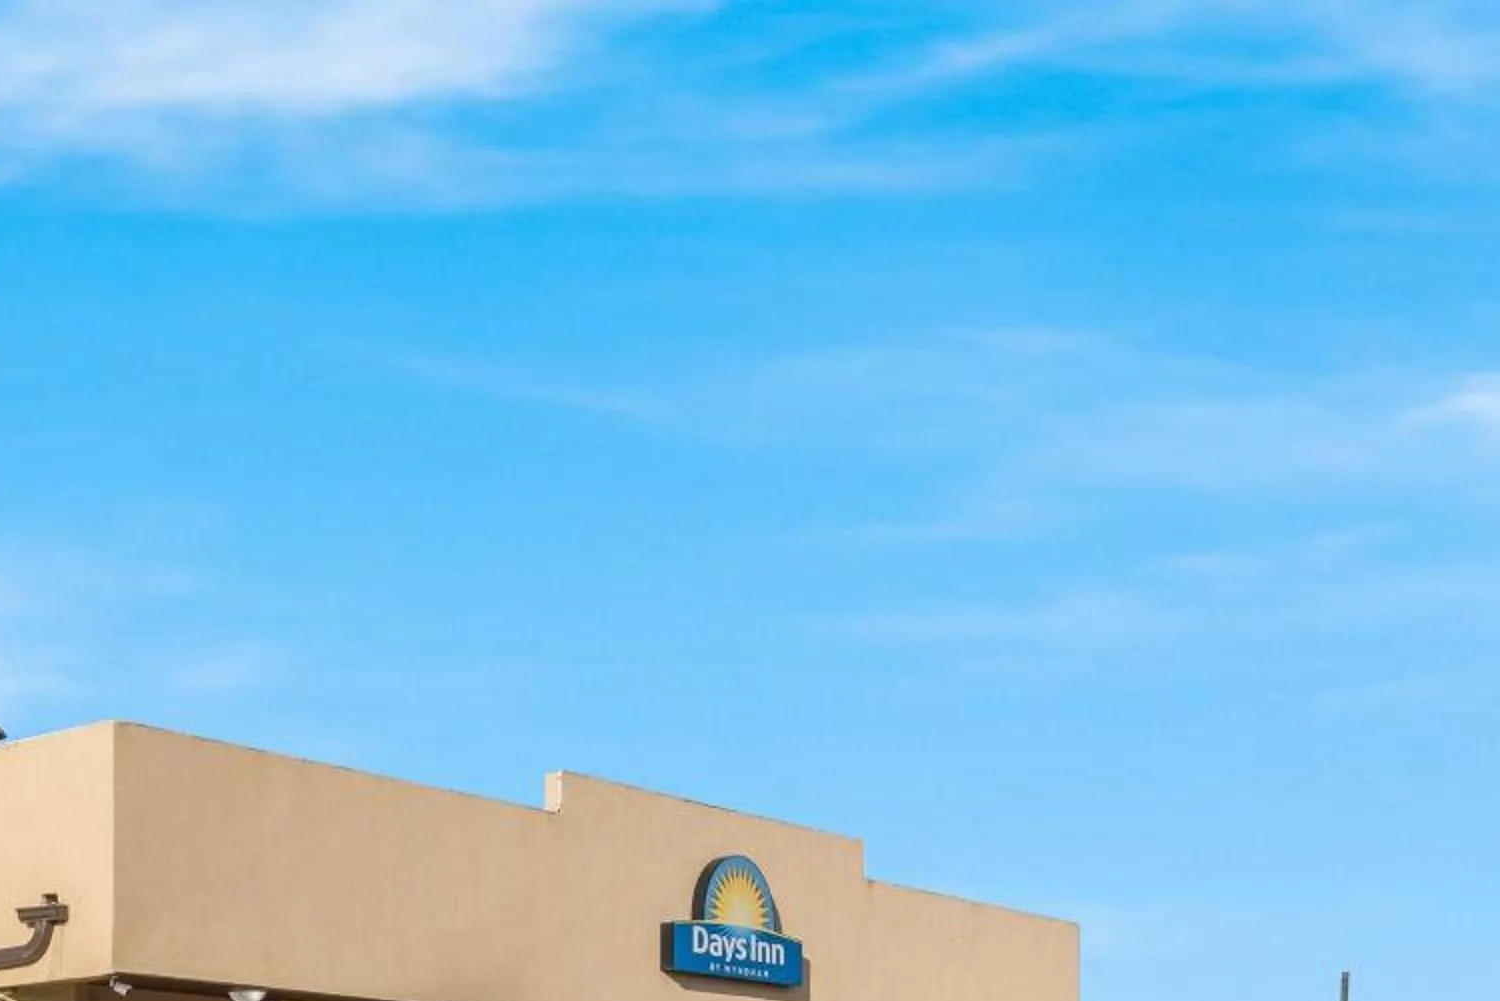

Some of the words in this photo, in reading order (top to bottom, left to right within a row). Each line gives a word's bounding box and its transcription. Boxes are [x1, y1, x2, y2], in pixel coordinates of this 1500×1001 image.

[692, 925, 747, 962] Days
[750, 934, 785, 966] Inn
[709, 961, 721, 972] BY
[723, 964, 770, 979] WYNDHAM
